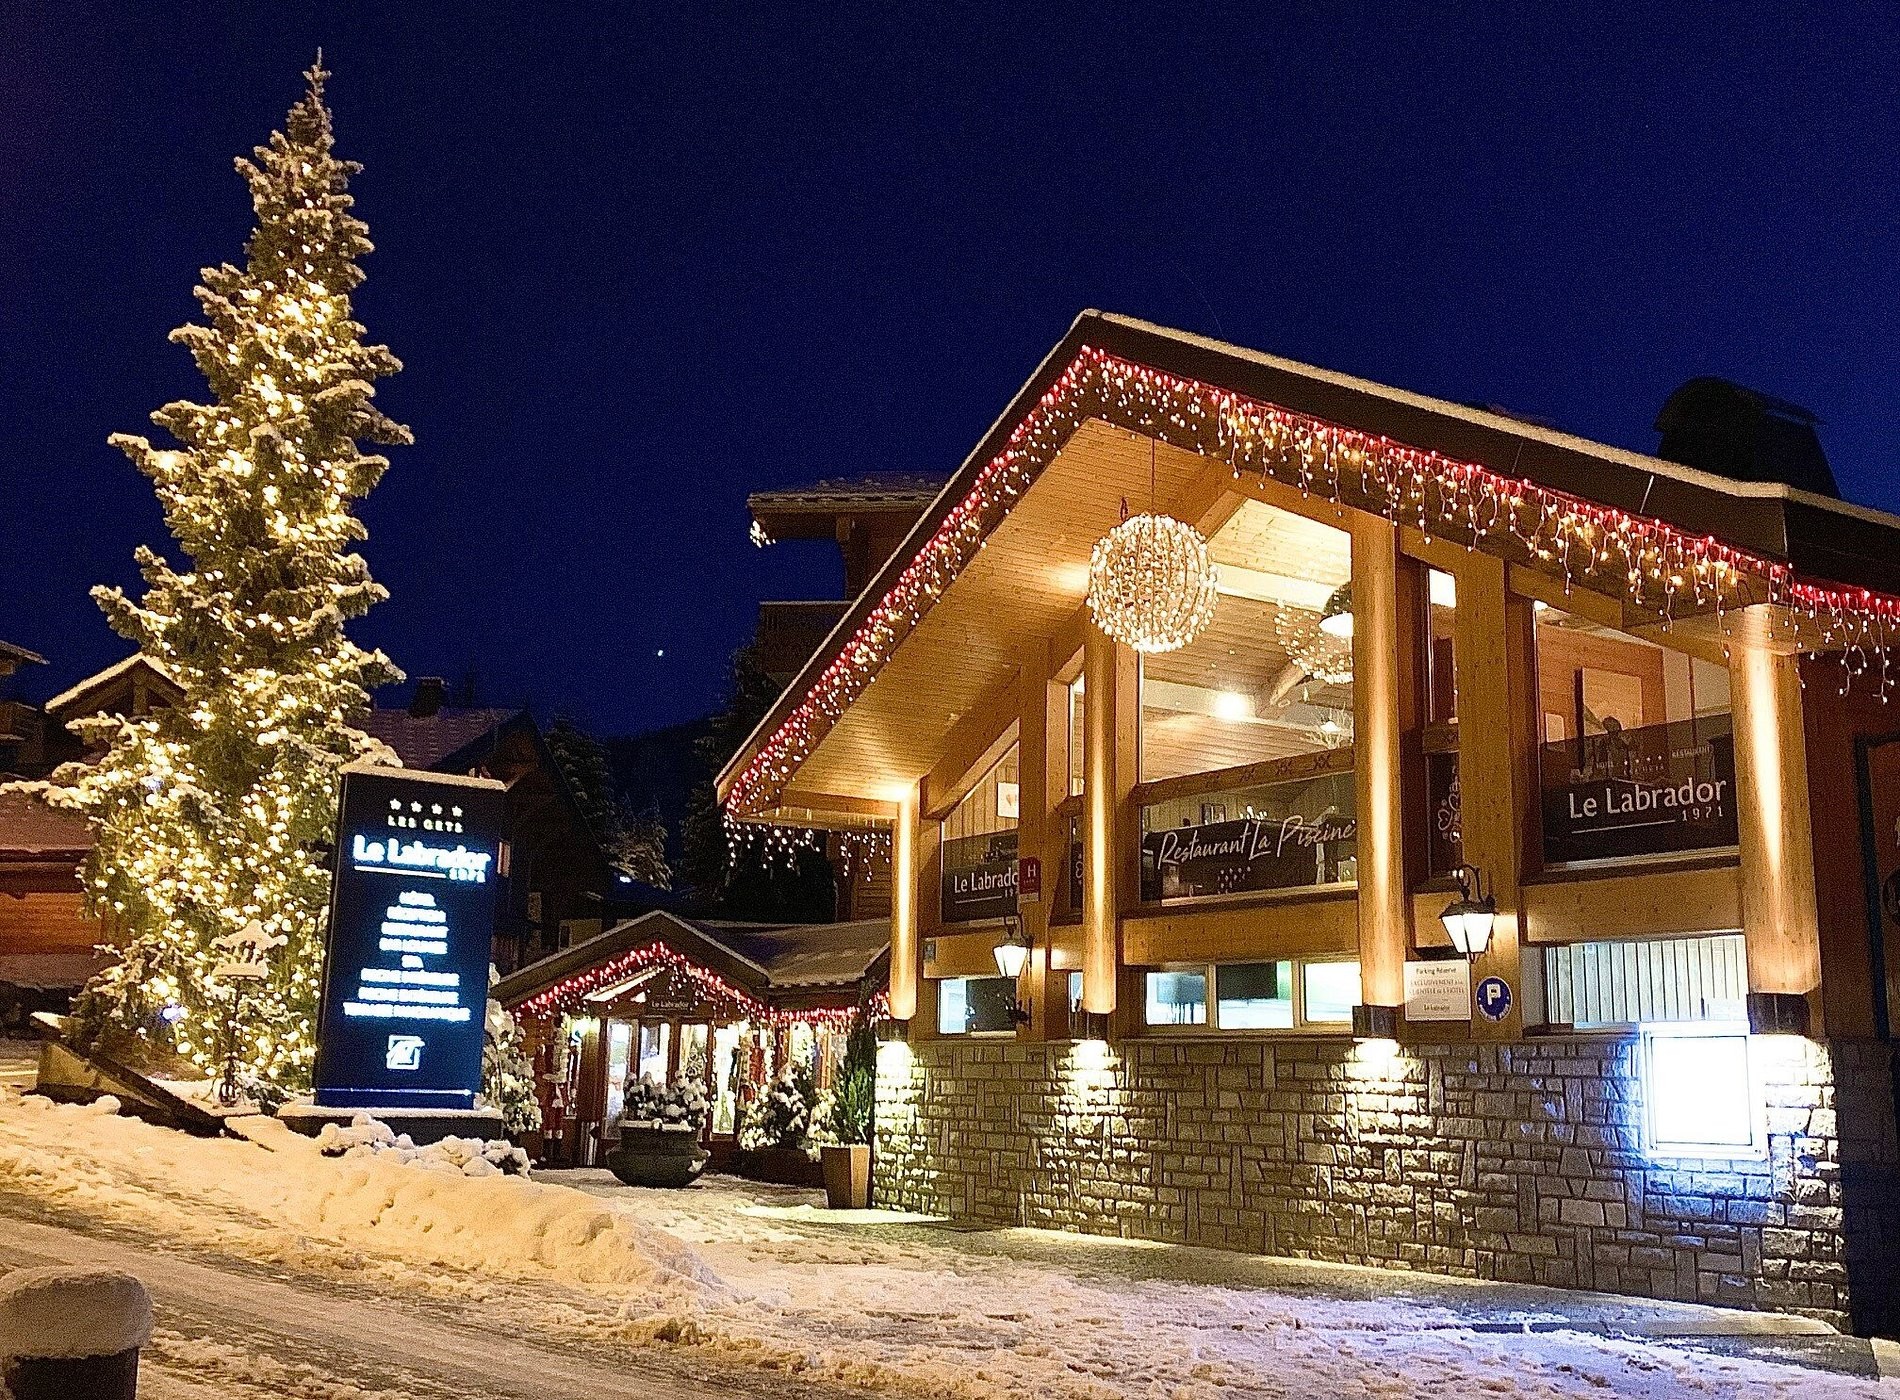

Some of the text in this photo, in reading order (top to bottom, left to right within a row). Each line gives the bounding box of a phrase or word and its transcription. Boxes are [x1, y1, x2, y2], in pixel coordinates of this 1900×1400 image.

[1569, 777, 1727, 819] Le Labrador
[1682, 806, 1723, 822] 1971
[353, 834, 492, 871] Le Labrador
[1157, 814, 1356, 870] Restaurant La Piscine
[954, 866, 1018, 894] Le Labrado
